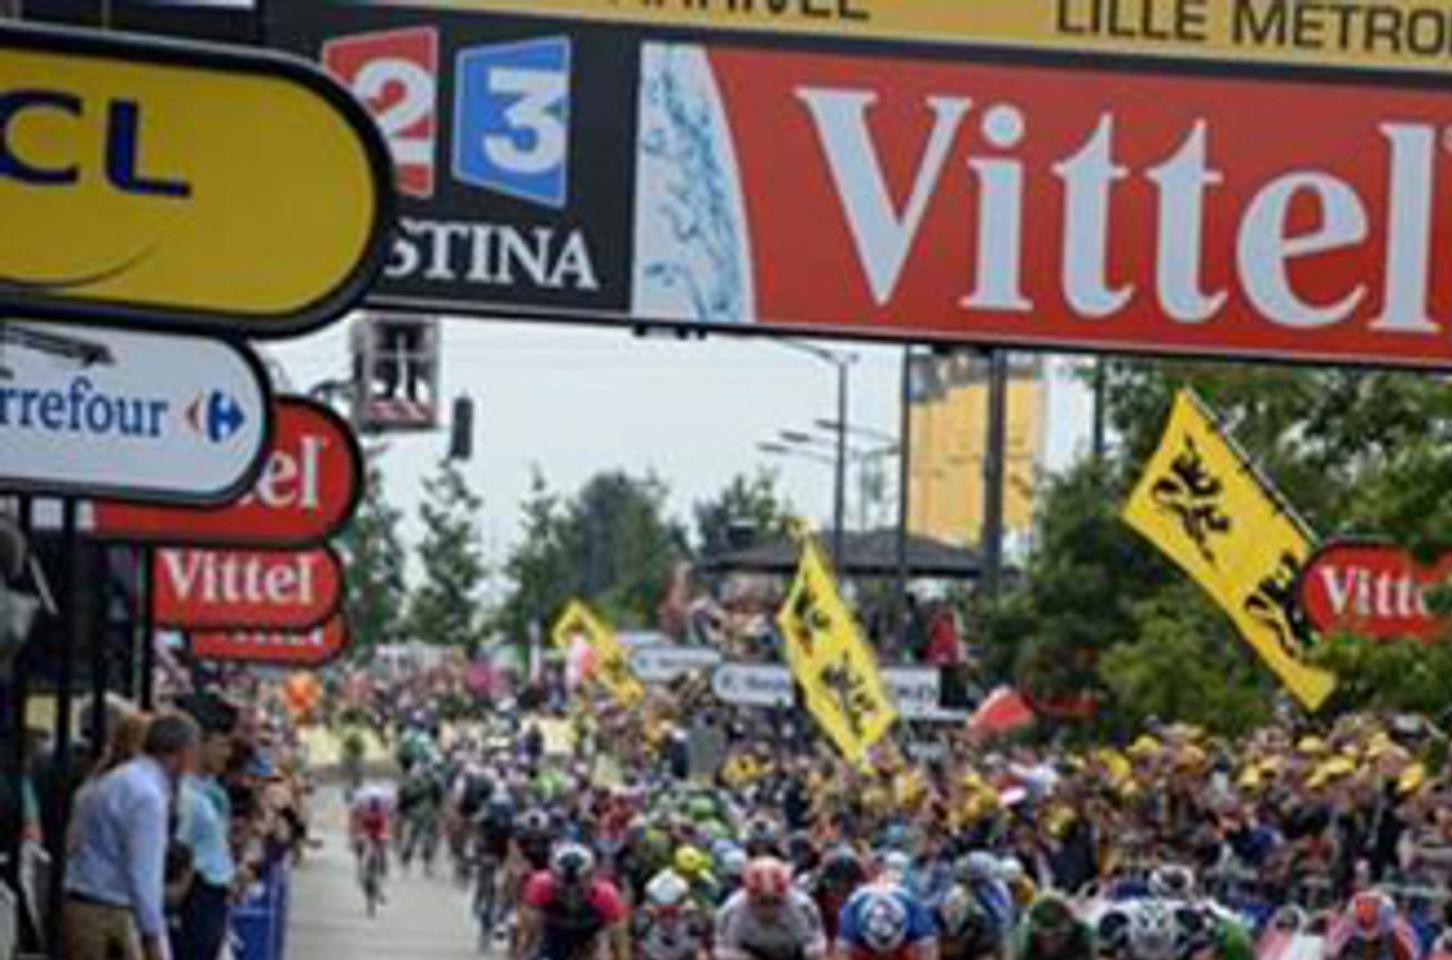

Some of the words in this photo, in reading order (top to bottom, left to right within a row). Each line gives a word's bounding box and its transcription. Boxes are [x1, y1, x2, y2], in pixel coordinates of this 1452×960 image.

[1055, 0, 1206, 42] LILLE
[484, 66, 569, 174] 3
[796, 86, 1441, 335] Vittel
[163, 550, 315, 606] Vittel
